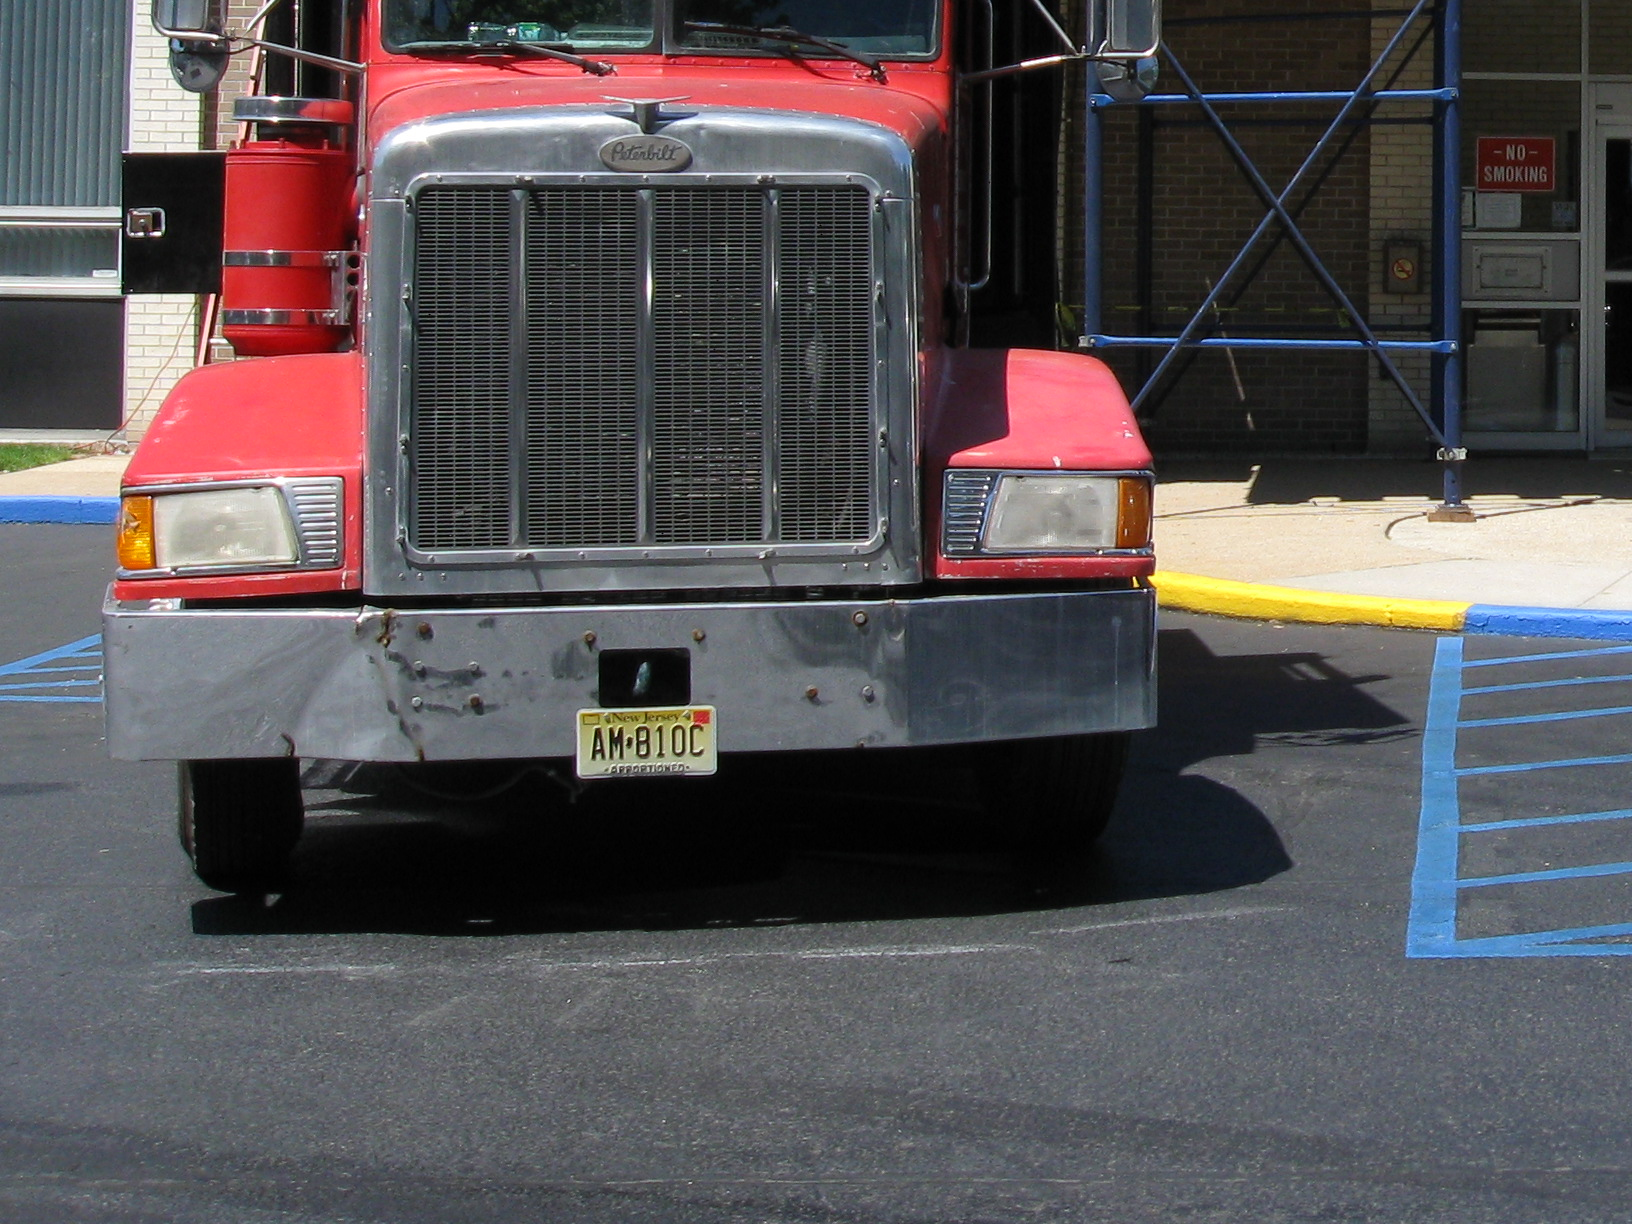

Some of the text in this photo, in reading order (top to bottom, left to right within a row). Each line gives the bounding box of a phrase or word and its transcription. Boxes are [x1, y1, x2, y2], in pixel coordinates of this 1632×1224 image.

[611, 142, 682, 162] Peterbilt
[1505, 144, 1526, 161] NO
[1484, 165, 1548, 183] SMOKING
[612, 711, 680, 724] New Jersey
